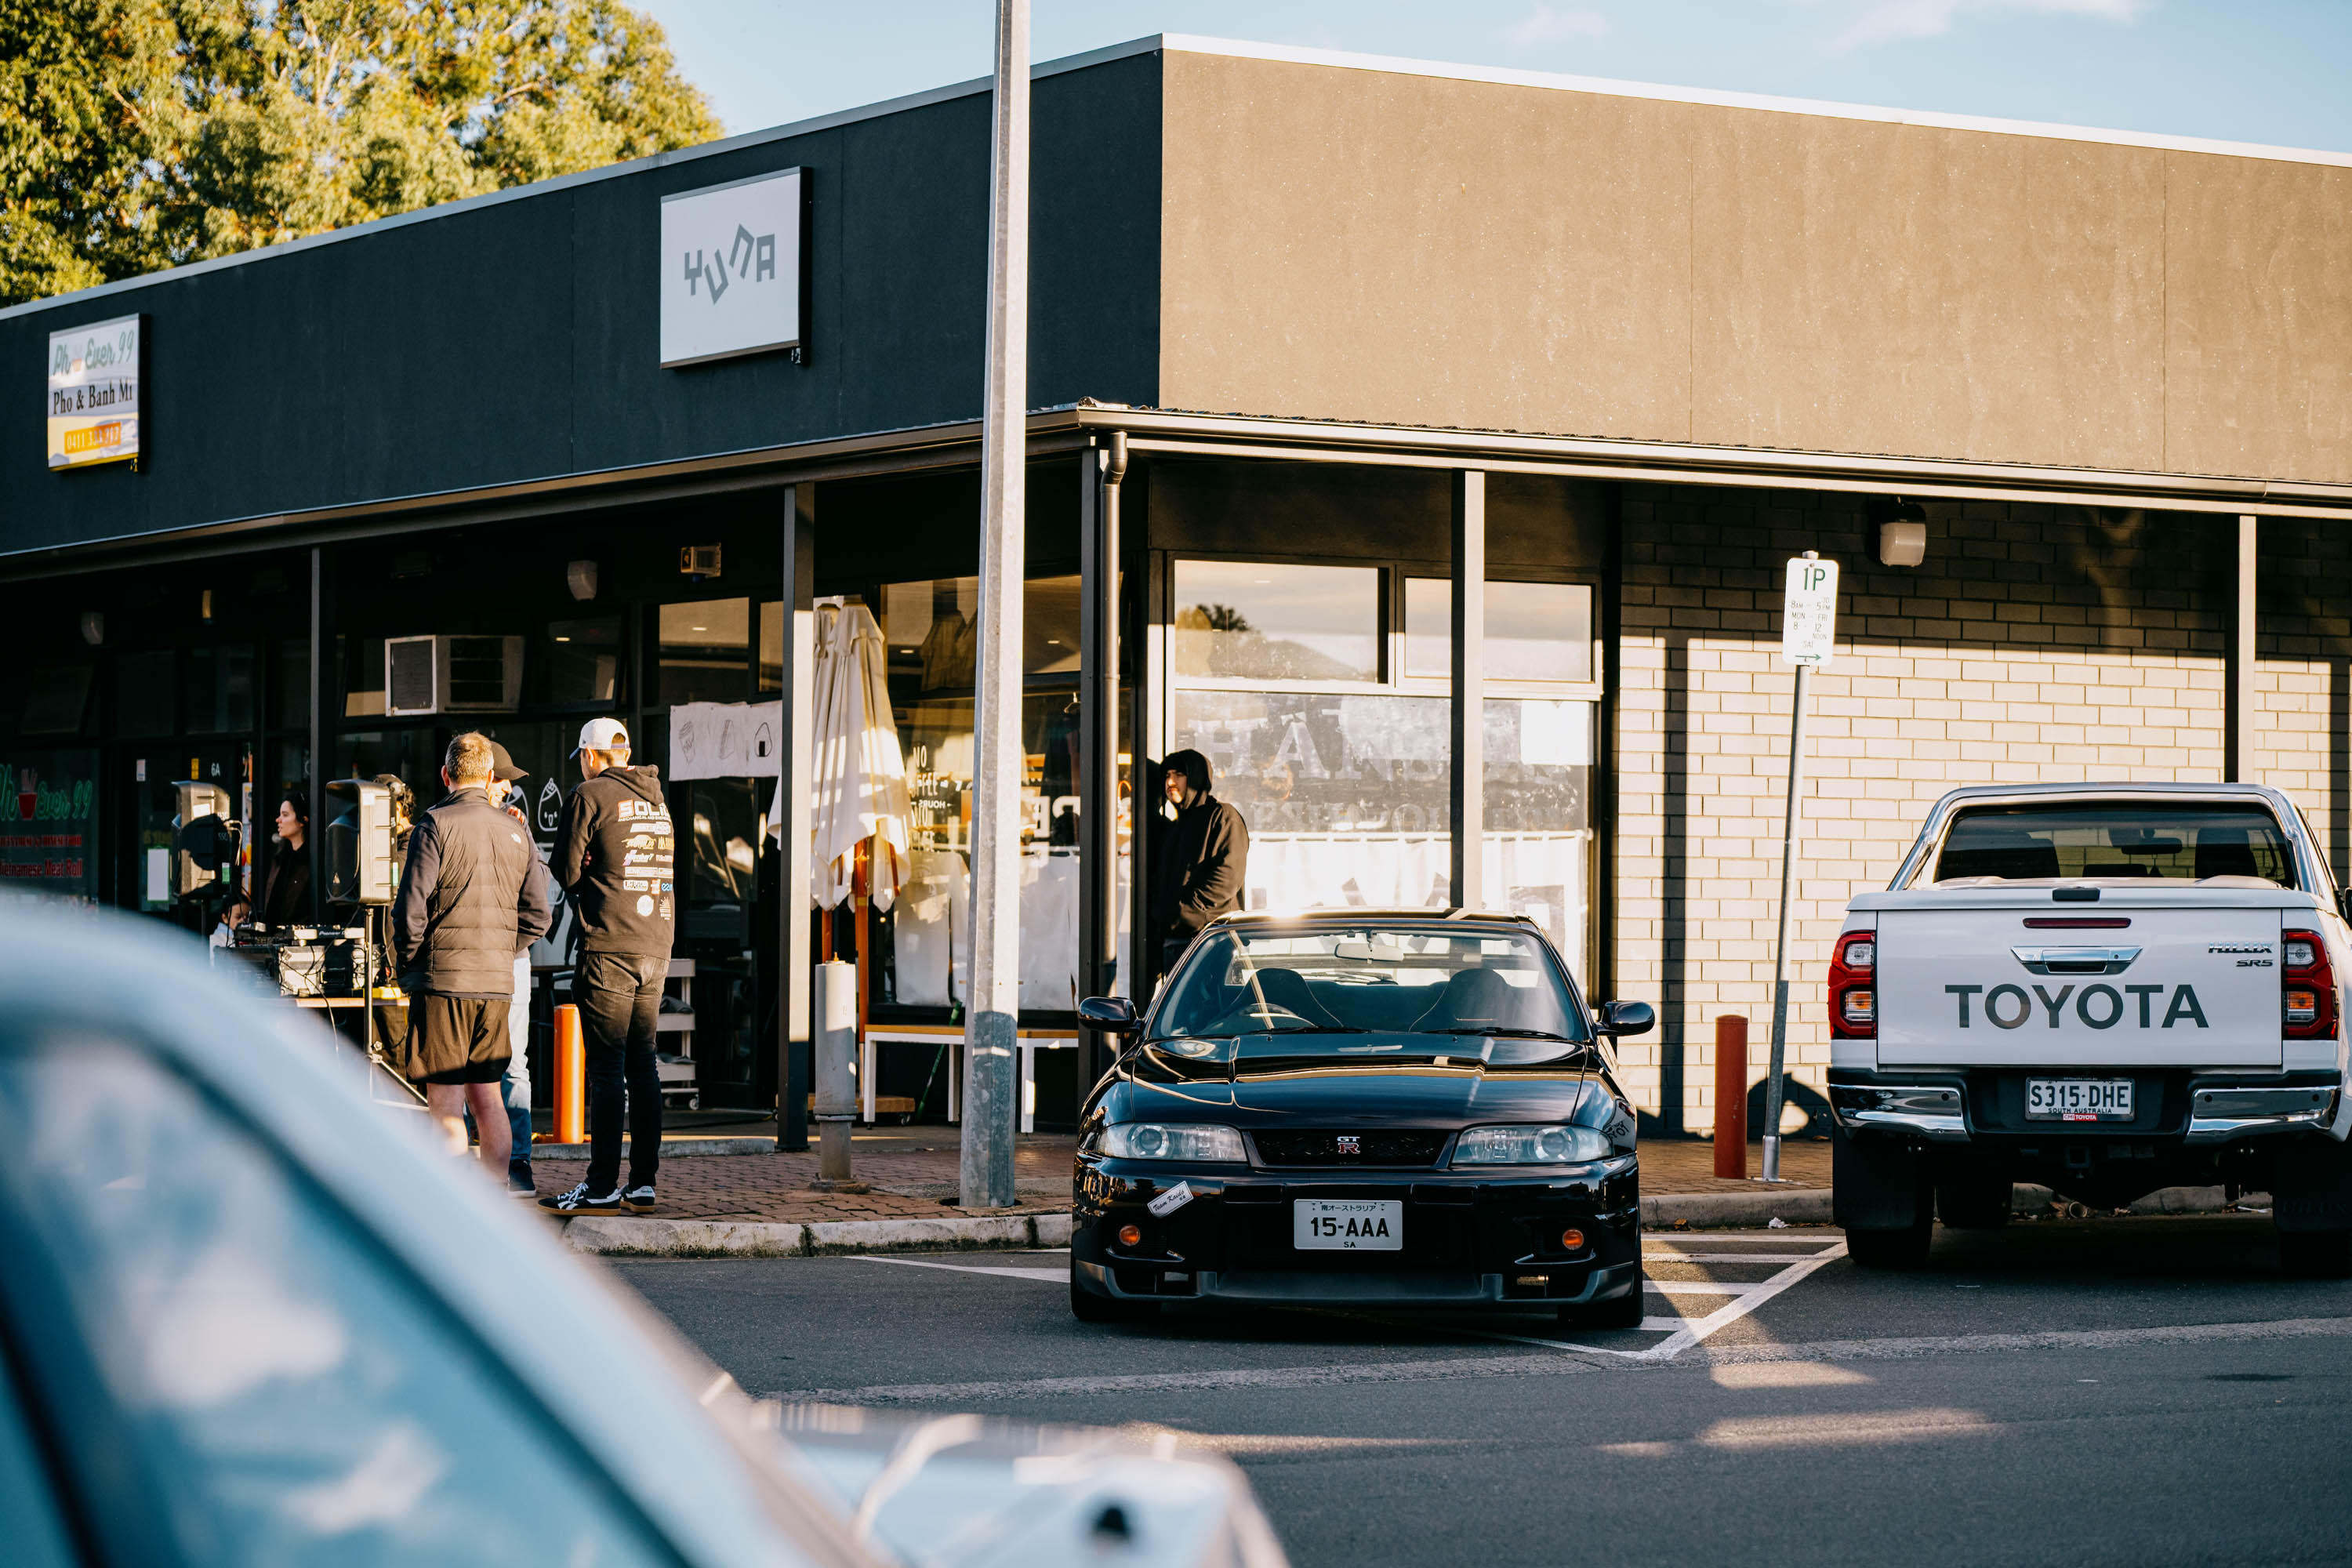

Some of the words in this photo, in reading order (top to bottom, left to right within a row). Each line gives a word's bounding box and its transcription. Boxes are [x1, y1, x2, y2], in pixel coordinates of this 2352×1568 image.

[684, 223, 775, 305] YUNA
[118, 329, 135, 364] 99
[53, 390, 73, 415] Pho
[76, 389, 85, 411] &
[89, 380, 116, 408] Banh
[118, 378, 132, 402] Mi
[67, 432, 86, 451] 0411
[1804, 567, 1826, 591] 1P
[1791, 601, 1803, 609] 8AM
[211, 763, 220, 777] 6A
[72, 780, 93, 819] 99
[45, 858, 64, 877] Meat
[66, 858, 82, 877] Roll
[2208, 942, 2274, 953] HILUX
[1944, 983, 2209, 1029] TOYOTA
[1338, 1142, 1361, 1154] R
[1152, 1201, 1167, 1211] Team
[1167, 1189, 1185, 1203] Kaido
[1310, 1217, 1390, 1237] 15-AAA
